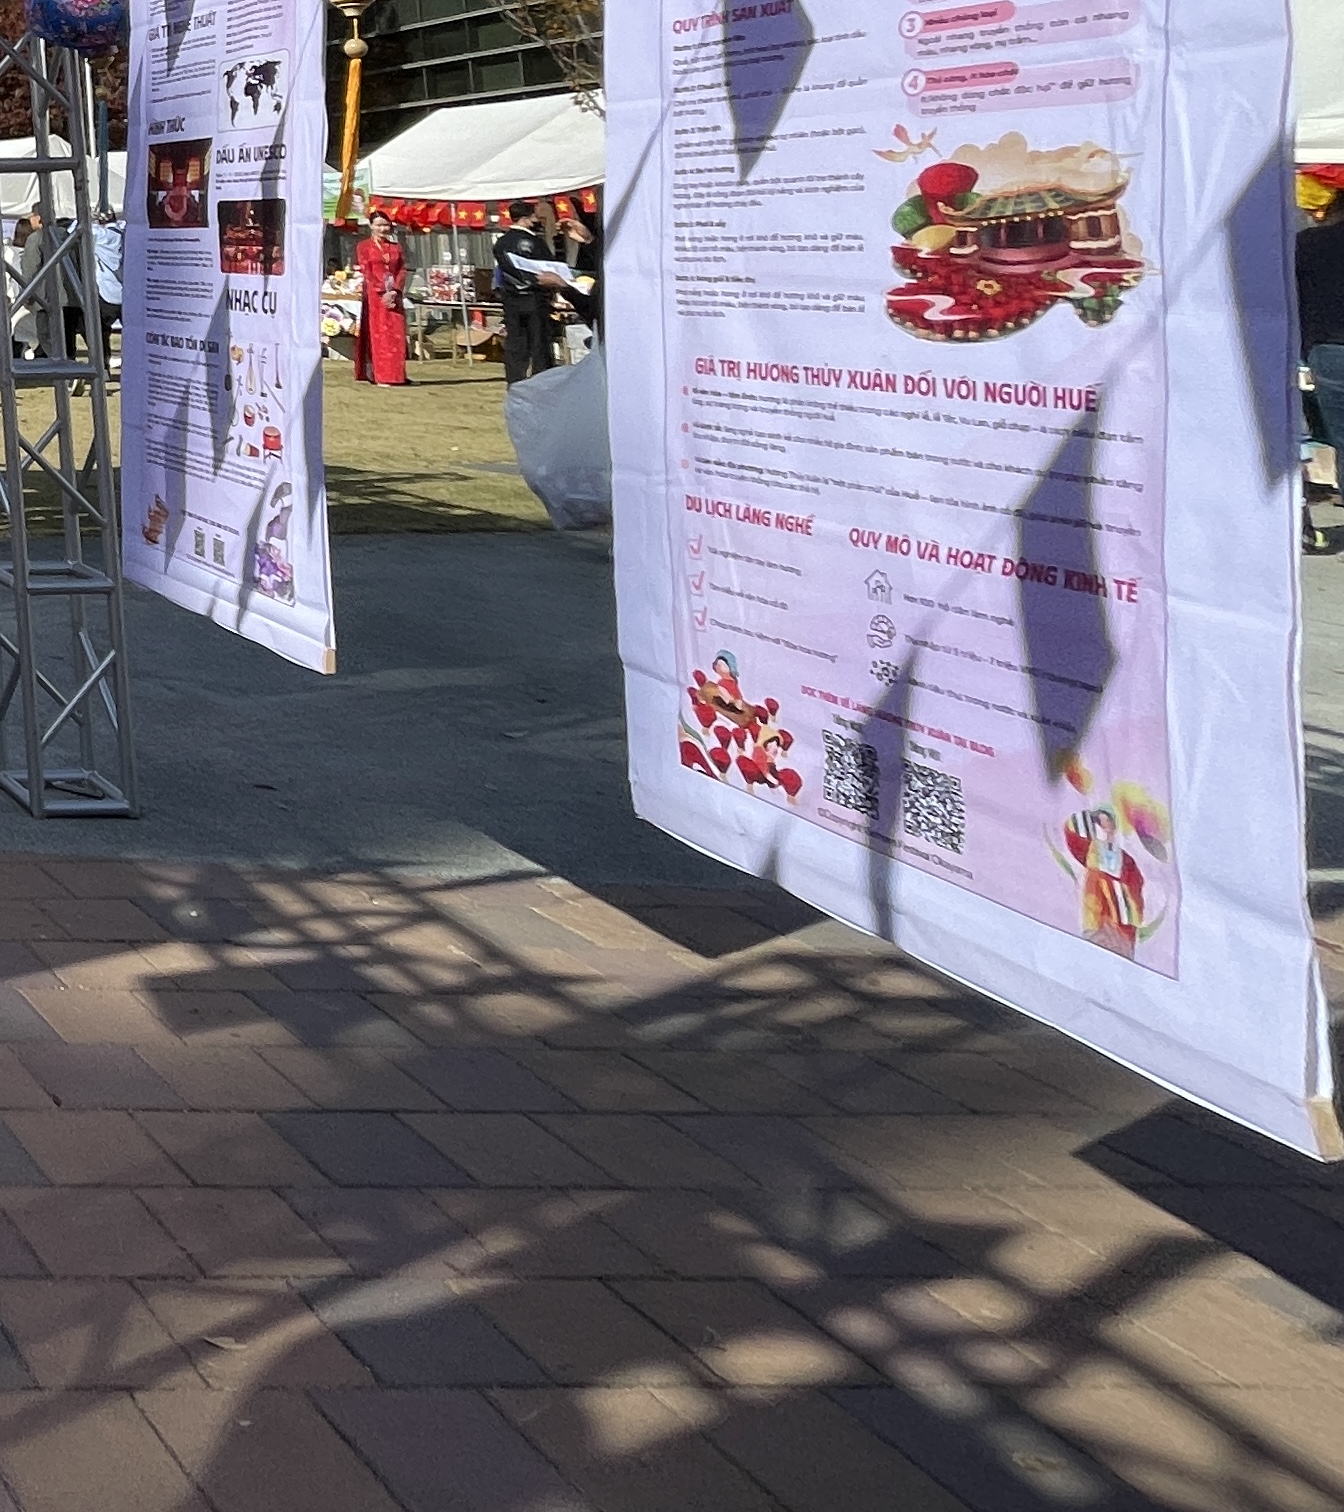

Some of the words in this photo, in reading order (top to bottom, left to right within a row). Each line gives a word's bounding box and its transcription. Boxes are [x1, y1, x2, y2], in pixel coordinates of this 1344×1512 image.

[226, 288, 258, 316] NHẠC
[262, 291, 277, 318] CỤ
[719, 358, 741, 381] TRỊ
[746, 361, 800, 384] HƯƠNG
[803, 362, 842, 388] THỦY
[847, 368, 897, 393] XUÂN
[903, 369, 937, 397] ĐỐI
[942, 375, 976, 402] VỚI
[984, 380, 1048, 409] NGƯỜI
[1053, 382, 1103, 413] HUẾ
[685, 494, 702, 513] DU
[705, 499, 732, 520] LỊCH
[736, 503, 771, 527] LÀNG
[848, 528, 881, 550] QUY
[885, 533, 911, 556] MÔ
[916, 539, 941, 564] VÀ
[946, 547, 997, 575] HOẠT
[1001, 557, 1059, 586] ĐỘNG
[1064, 568, 1108, 598] KINH
[1113, 577, 1142, 603] TẾ
